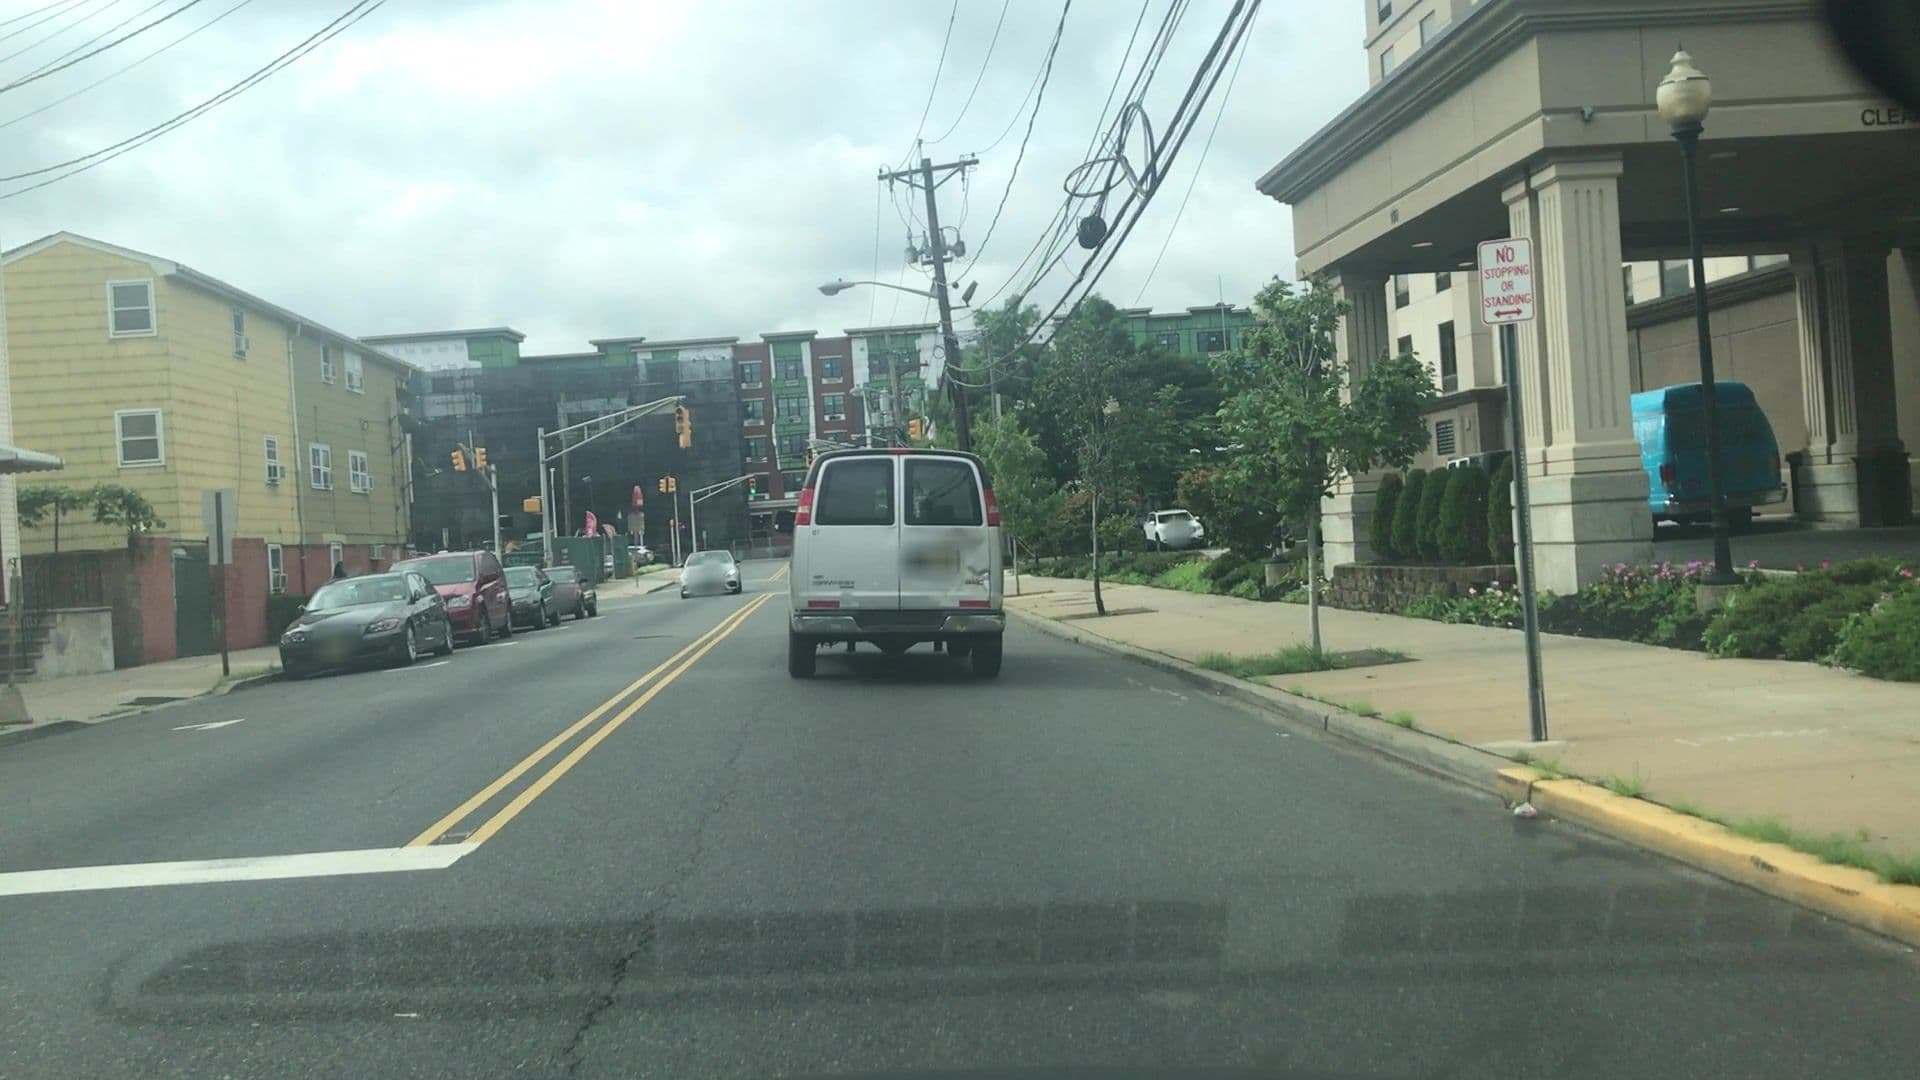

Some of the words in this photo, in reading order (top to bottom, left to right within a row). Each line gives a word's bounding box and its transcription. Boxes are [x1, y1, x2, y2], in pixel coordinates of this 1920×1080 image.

[1496, 246, 1515, 264] NO
[1484, 264, 1530, 280] STOPPING
[1501, 280, 1515, 292] OR
[1484, 293, 1533, 308] STANDING
